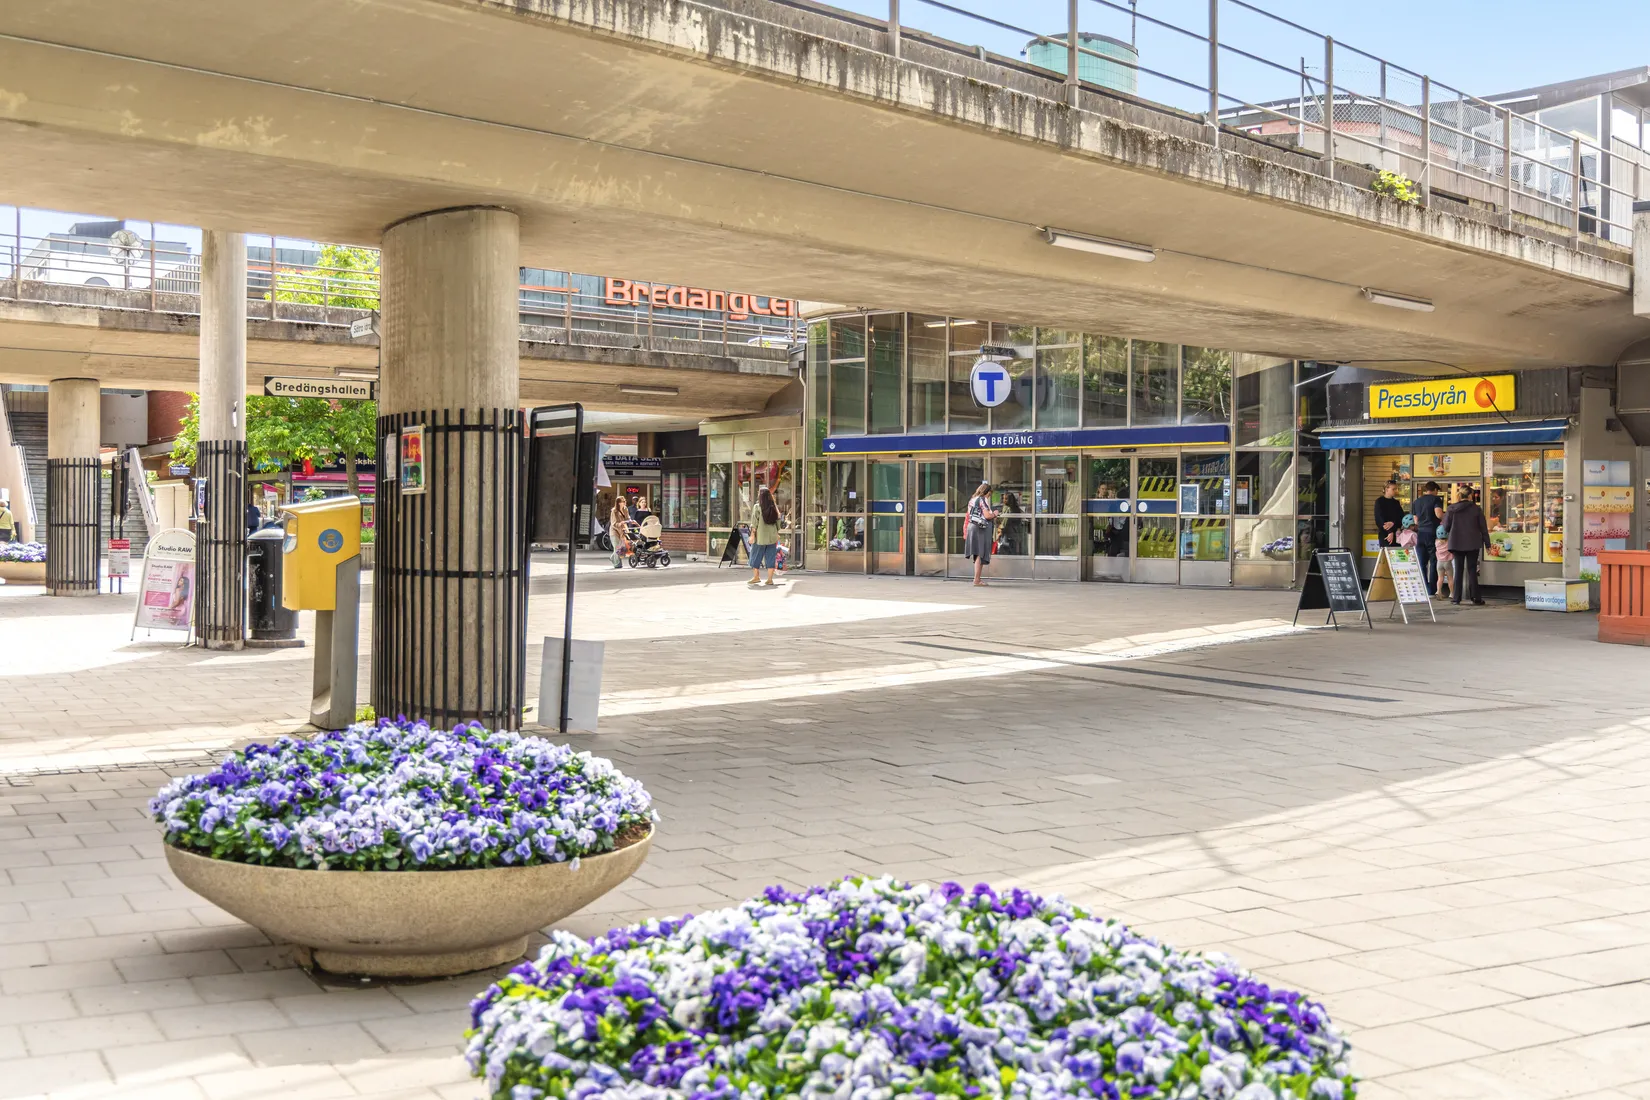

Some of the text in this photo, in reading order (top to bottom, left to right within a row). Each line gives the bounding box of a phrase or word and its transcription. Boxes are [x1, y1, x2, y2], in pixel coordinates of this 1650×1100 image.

[275, 382, 366, 395] Bredängshallen
[978, 372, 1003, 402] T
[1378, 385, 1467, 411] Pressbyrån
[991, 435, 1033, 446] BREDÄNG
[338, 457, 376, 465] Qksho
[1525, 594, 1545, 603] Förenkla
